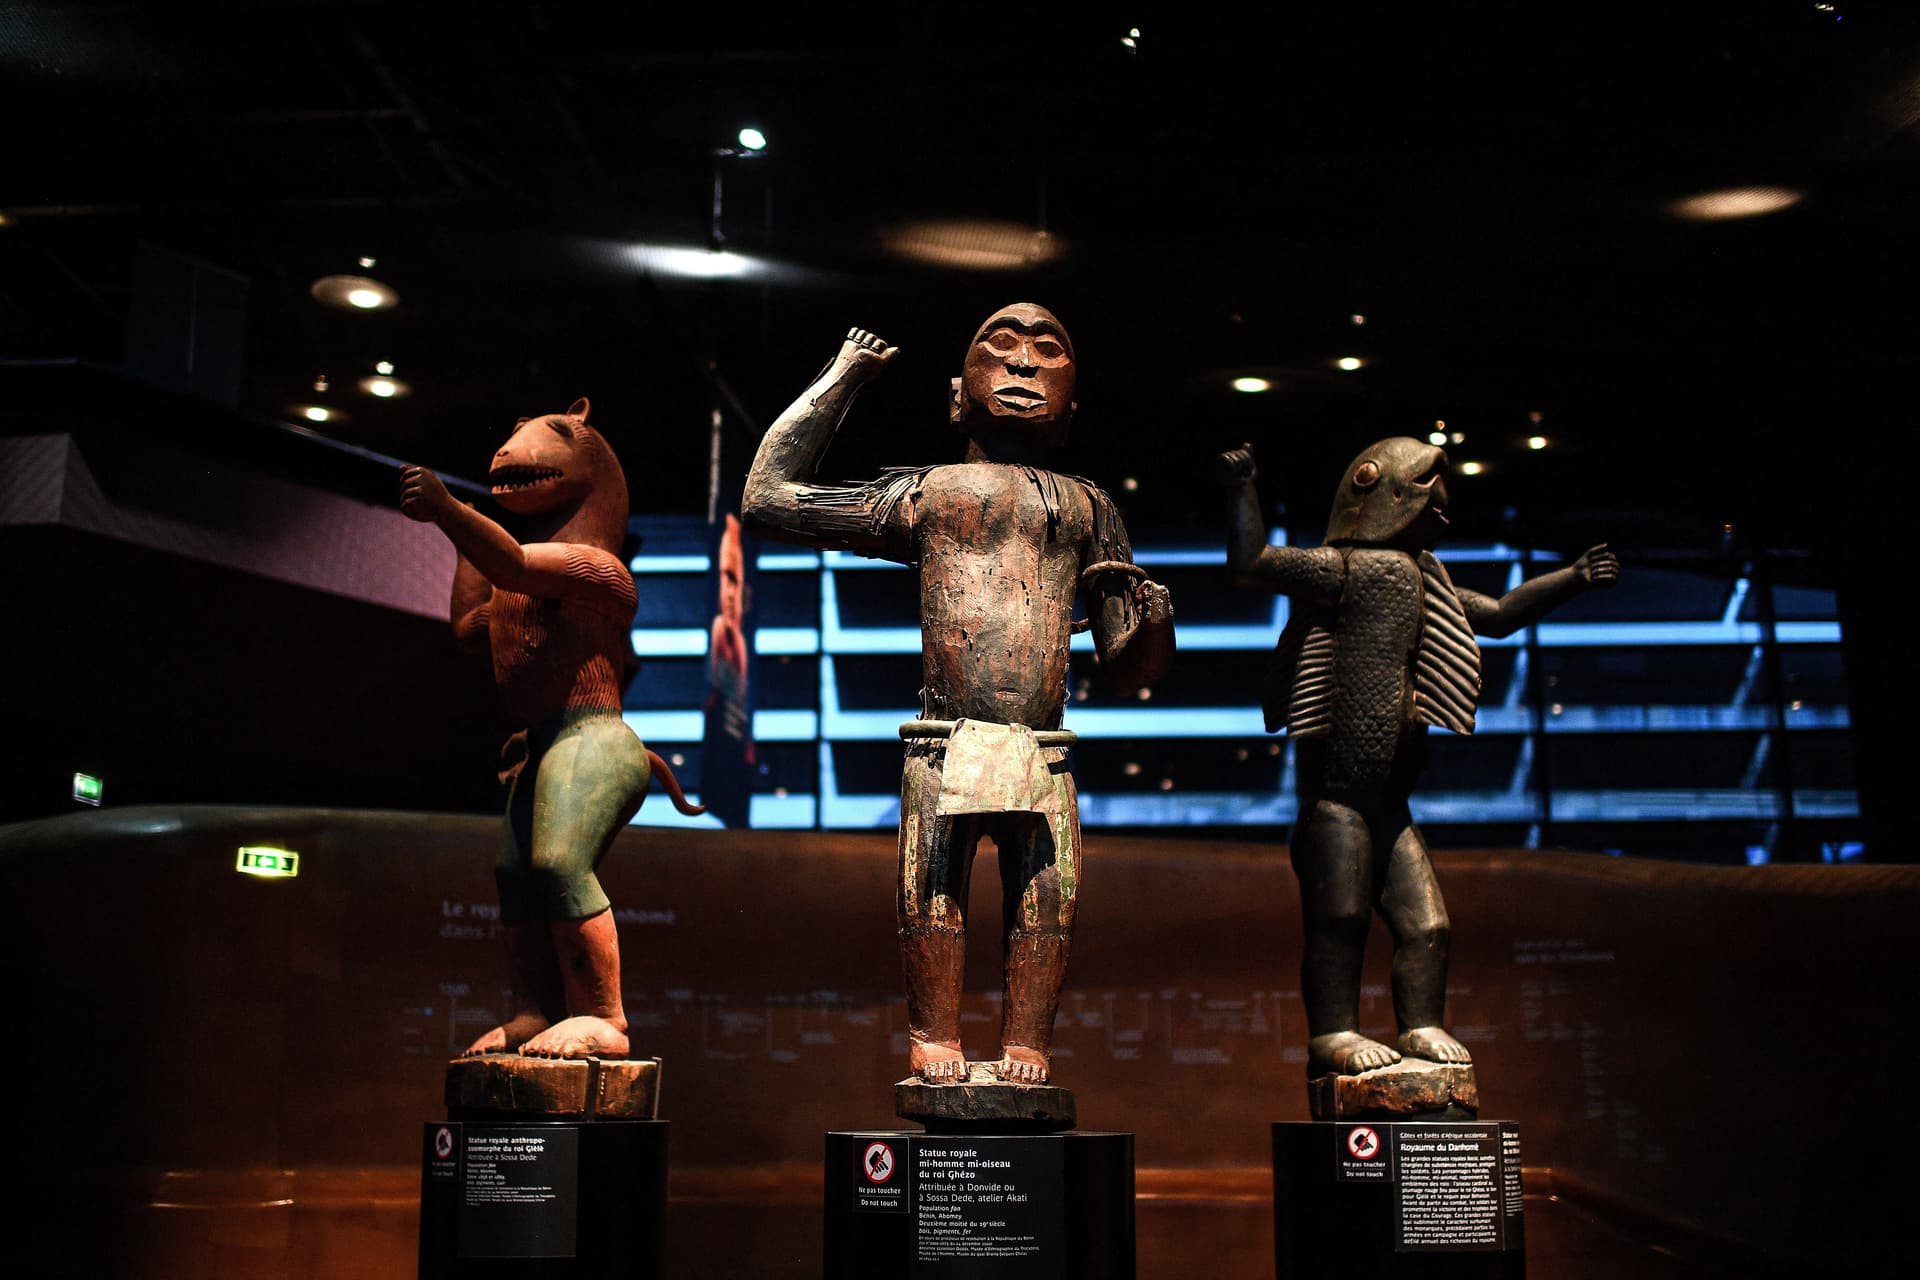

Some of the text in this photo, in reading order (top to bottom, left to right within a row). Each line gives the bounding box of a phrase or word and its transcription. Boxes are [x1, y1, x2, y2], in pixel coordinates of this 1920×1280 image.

[1401, 1144, 1435, 1152] Royaume
[1436, 1143, 1446, 1151] du
[920, 1148, 978, 1158] Statue royale
[919, 1170, 976, 1180] du roi Ghézo
[919, 1183, 957, 1191] Attribuée
[959, 1183, 964, 1191] à
[967, 1183, 1001, 1191] Donvide
[919, 1194, 1028, 1203] à Sossa Dede, atelier Akati
